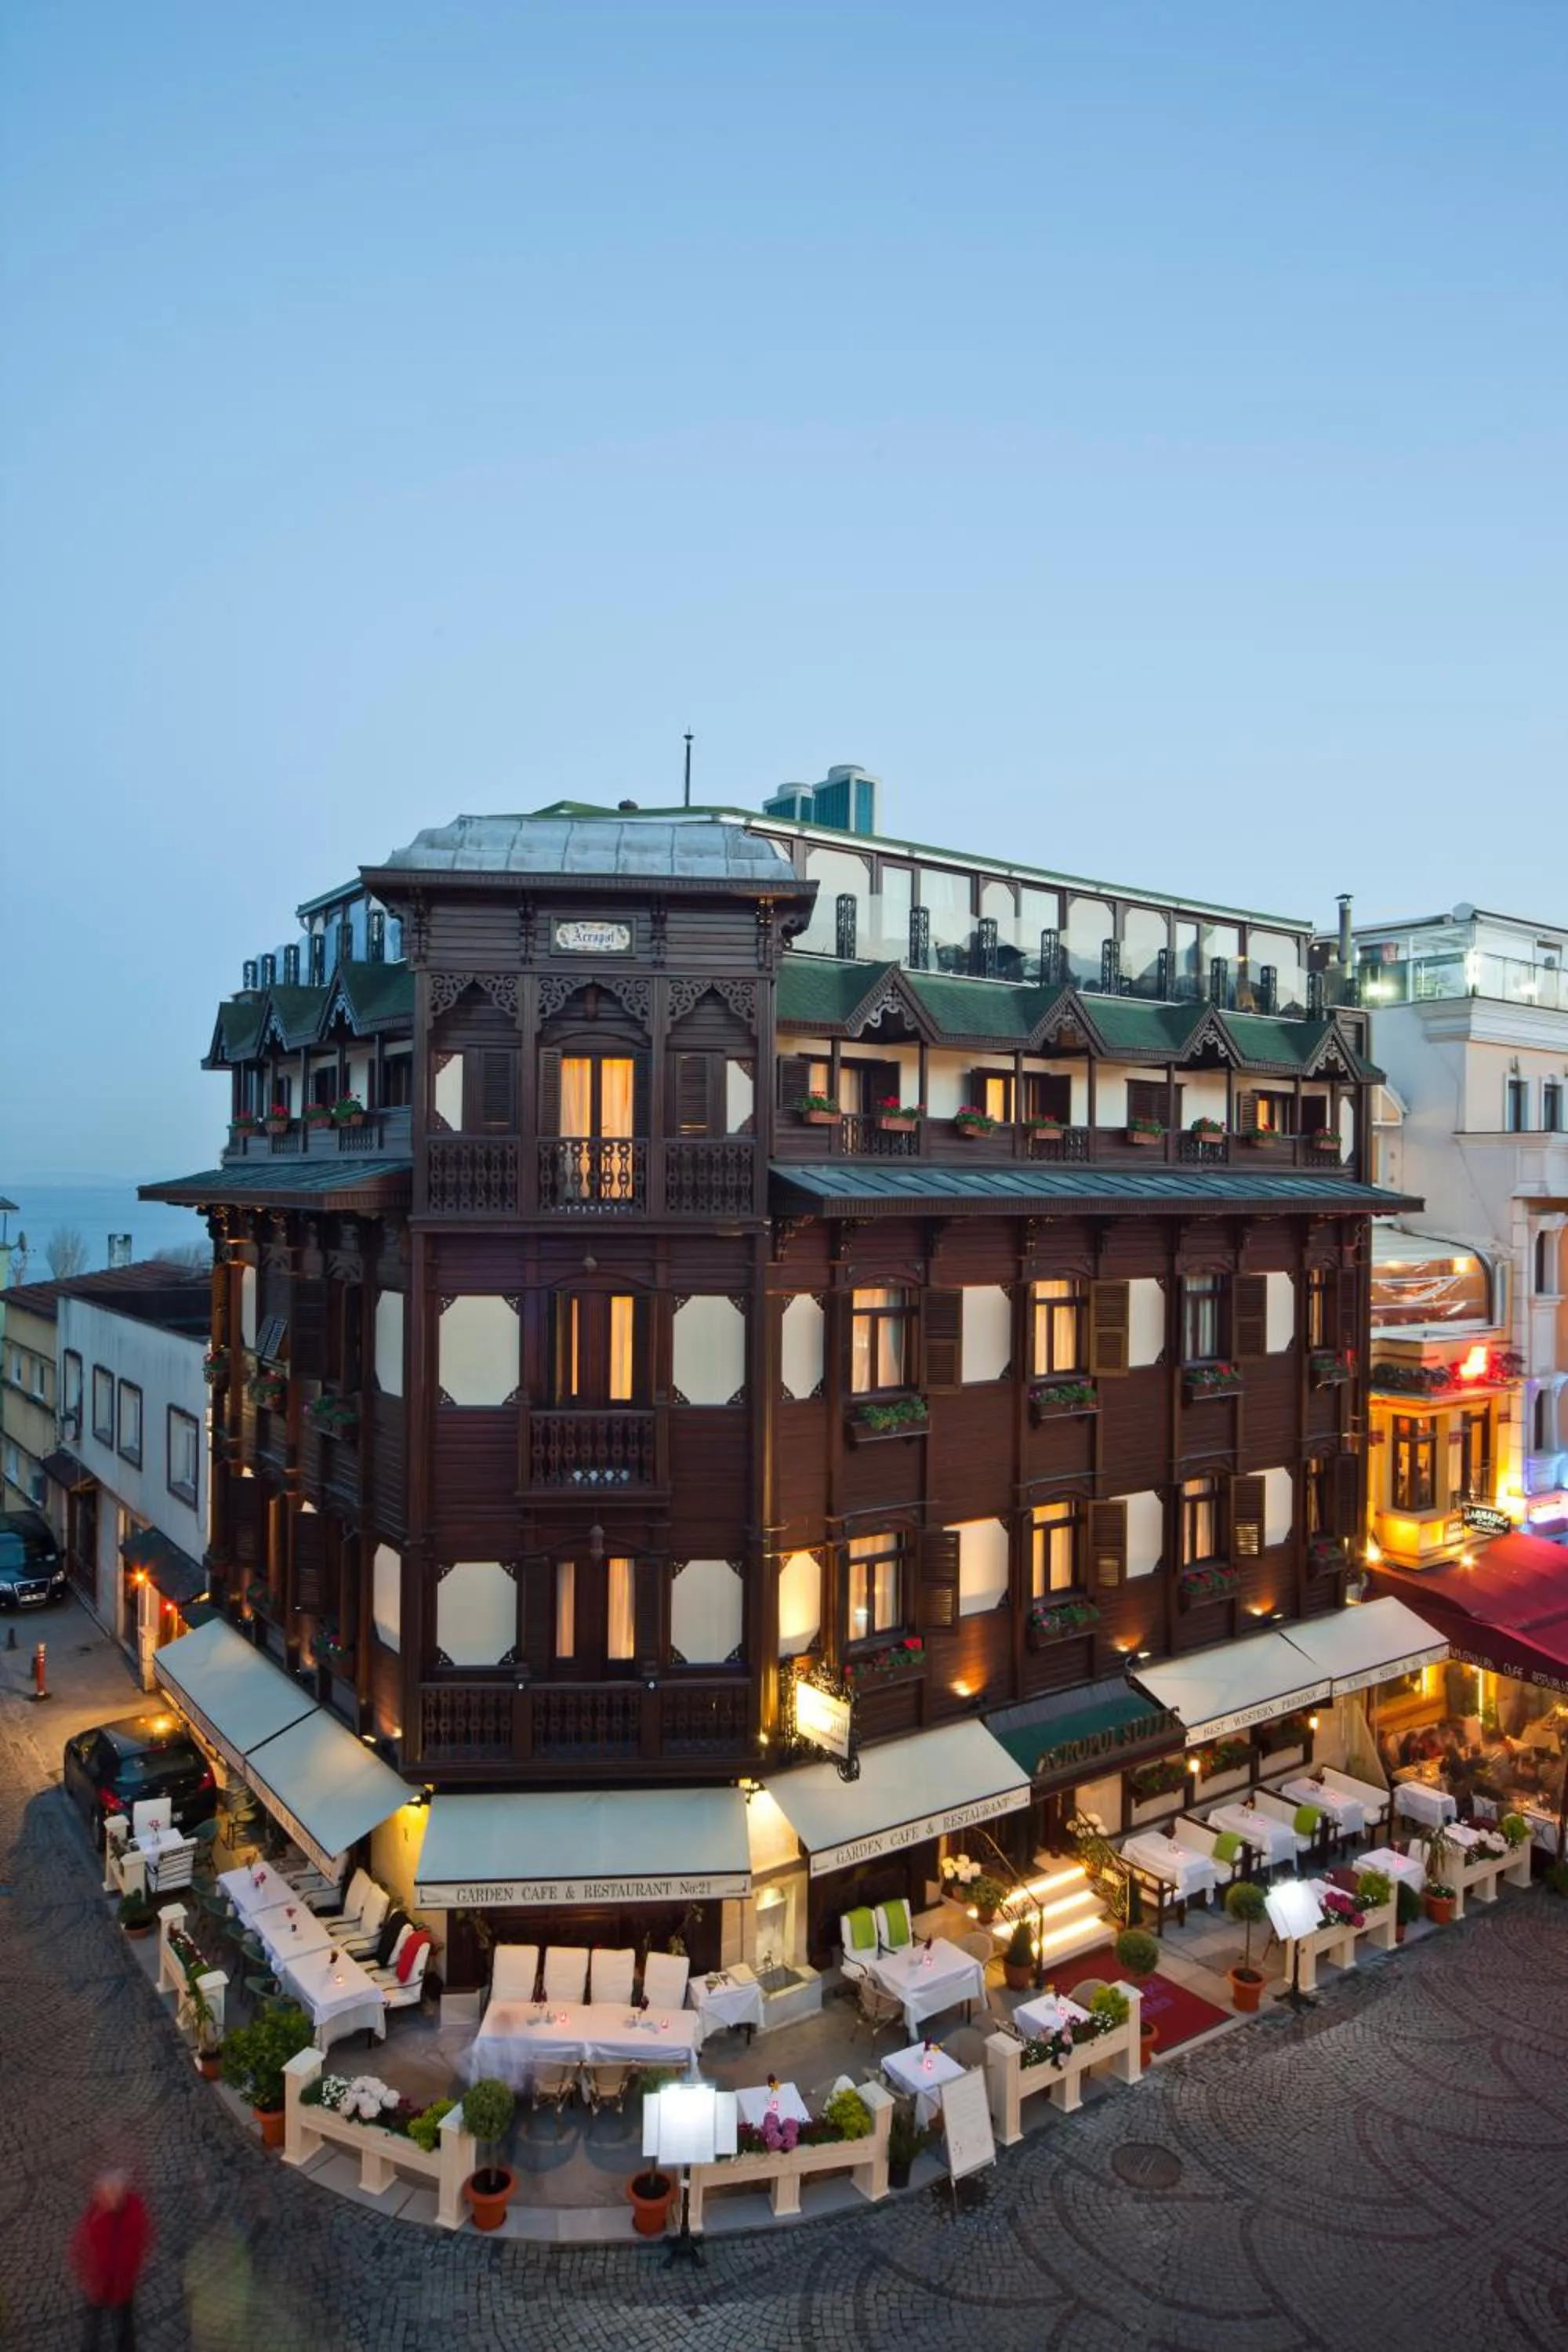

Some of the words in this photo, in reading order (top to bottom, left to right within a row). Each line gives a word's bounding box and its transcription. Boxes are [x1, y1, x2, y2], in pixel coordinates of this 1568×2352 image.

[1203, 1721, 1225, 1738] BEST
[1233, 1704, 1276, 1726] WESTERN
[836, 1838, 882, 1864] GARDEN
[890, 1825, 920, 1846] CAFE
[926, 1821, 935, 1835] &
[943, 1795, 1011, 1830] RESTAURANT
[457, 1886, 514, 1903] GARDEN
[522, 1884, 557, 1900] CAFE
[565, 1884, 575, 1900] &
[583, 1882, 672, 1898] RESTAURANT
